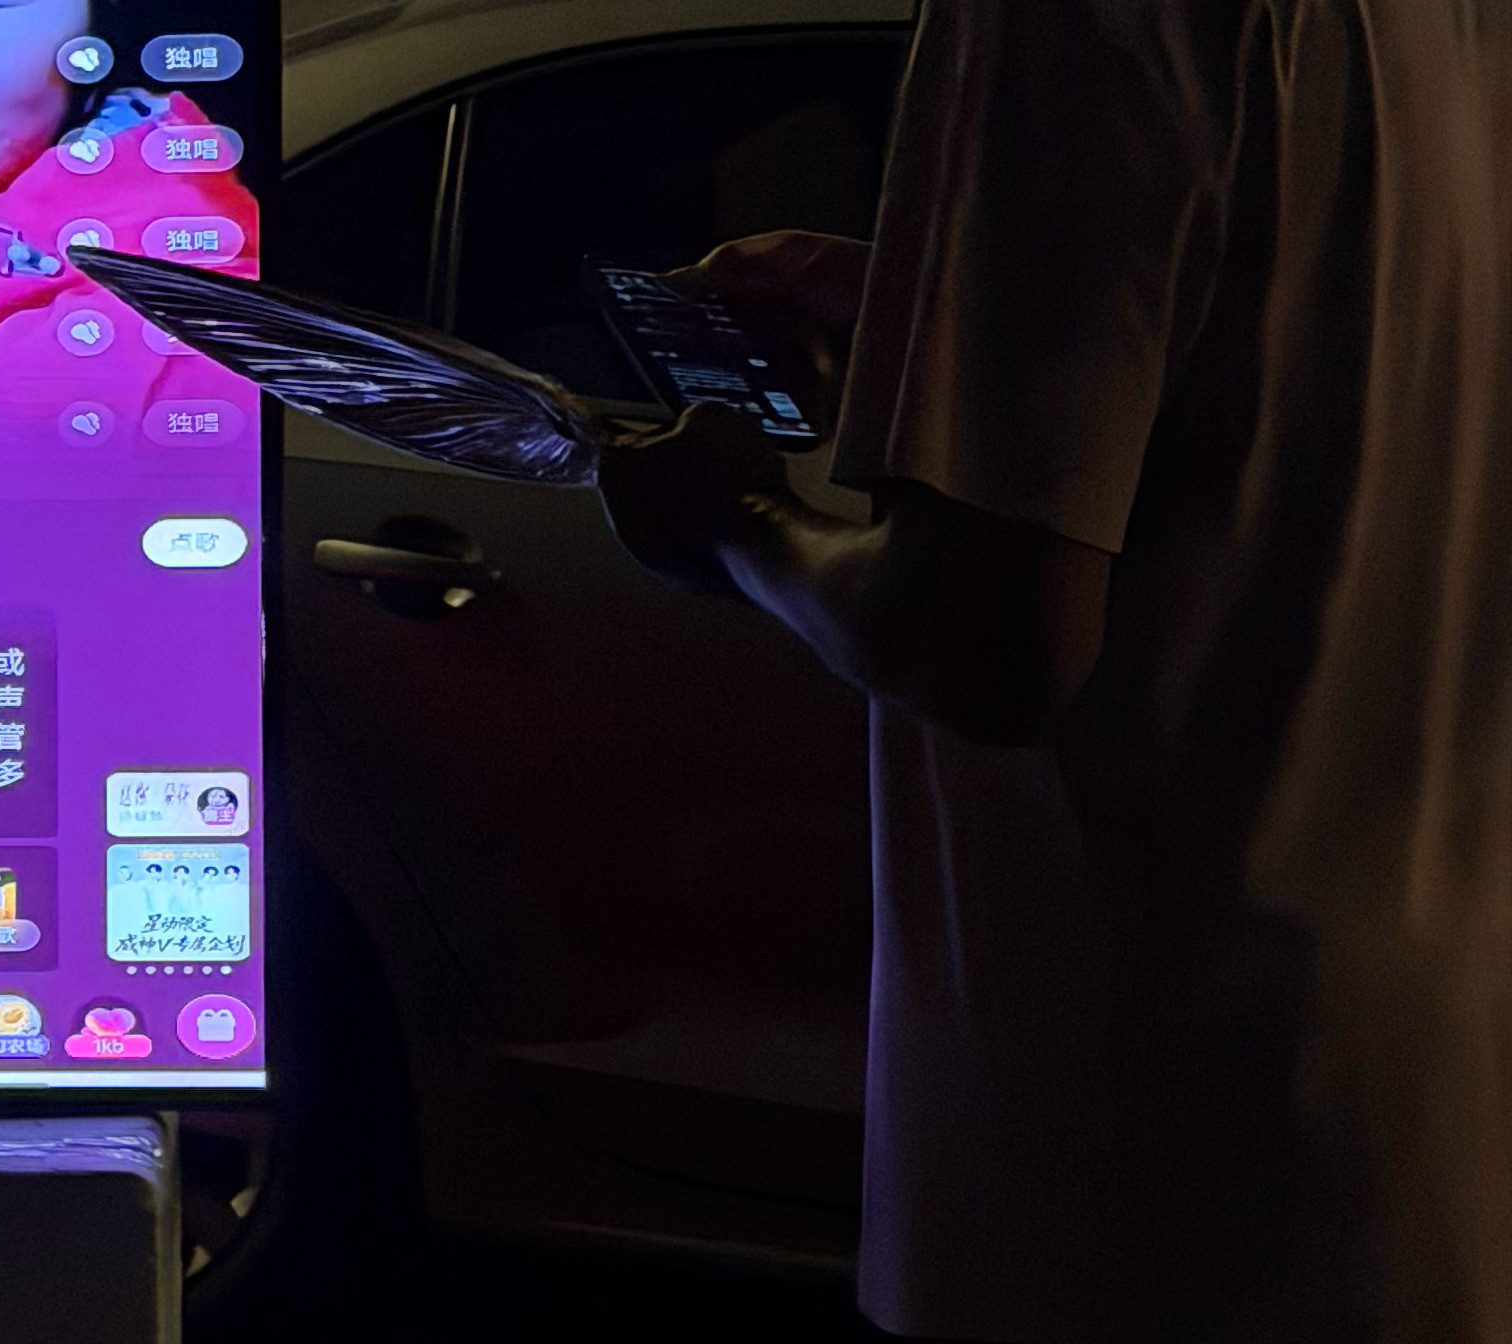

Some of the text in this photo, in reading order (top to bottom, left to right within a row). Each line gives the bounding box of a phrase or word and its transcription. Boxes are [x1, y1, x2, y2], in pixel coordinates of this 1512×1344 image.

[165, 47, 219, 69] 独唱
[166, 139, 219, 161] 独唱
[167, 229, 219, 251] 独唱
[168, 412, 220, 434] 独唱
